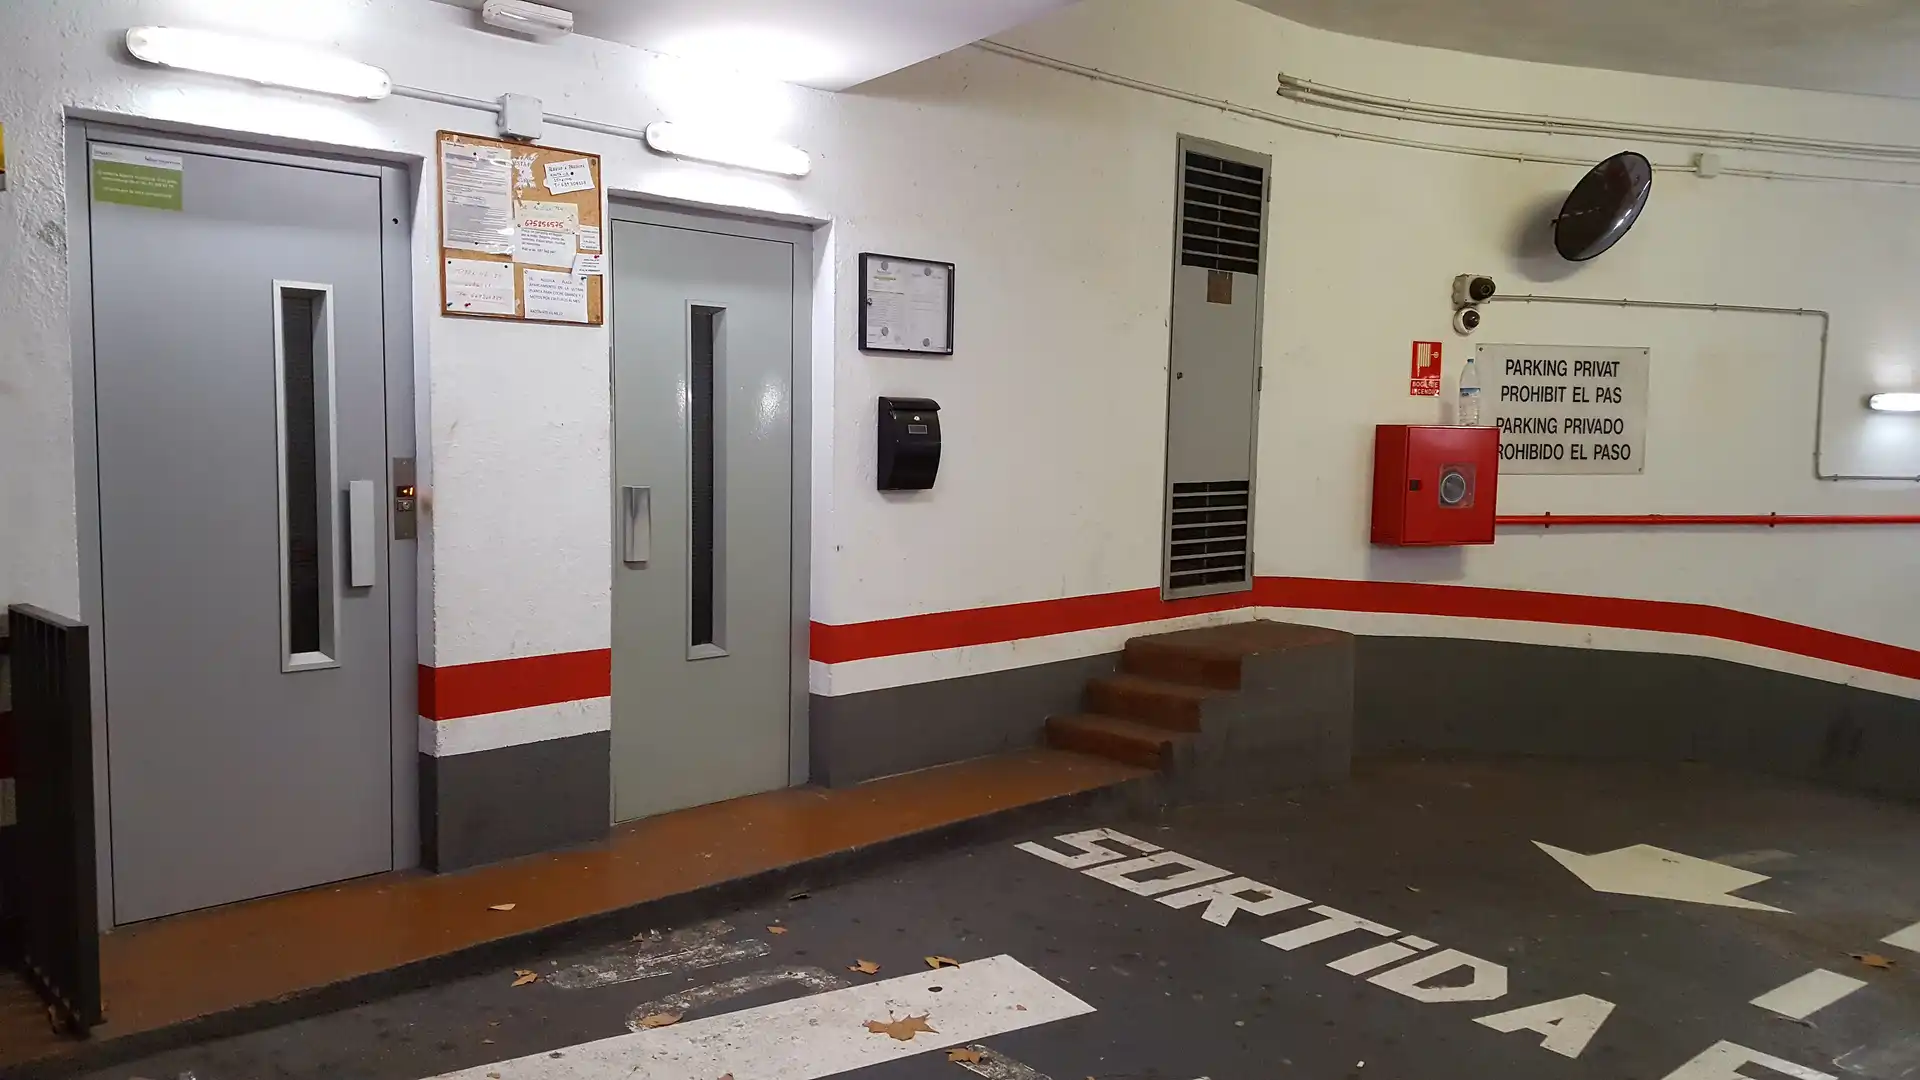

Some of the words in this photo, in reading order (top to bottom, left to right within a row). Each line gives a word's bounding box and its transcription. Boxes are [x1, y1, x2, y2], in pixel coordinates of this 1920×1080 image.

[1505, 359, 1568, 377] PARKING
[1574, 360, 1620, 378] PRIVAT
[1500, 385, 1567, 402] PROHIBIT
[1572, 386, 1590, 403] EL
[1596, 387, 1622, 404] PAS
[1496, 417, 1558, 434] PARKING
[1564, 418, 1624, 435] PRIVADO
[1498, 443, 1564, 460] ROHIBIDO
[1570, 443, 1588, 460] EL
[1594, 444, 1631, 460] PASO
